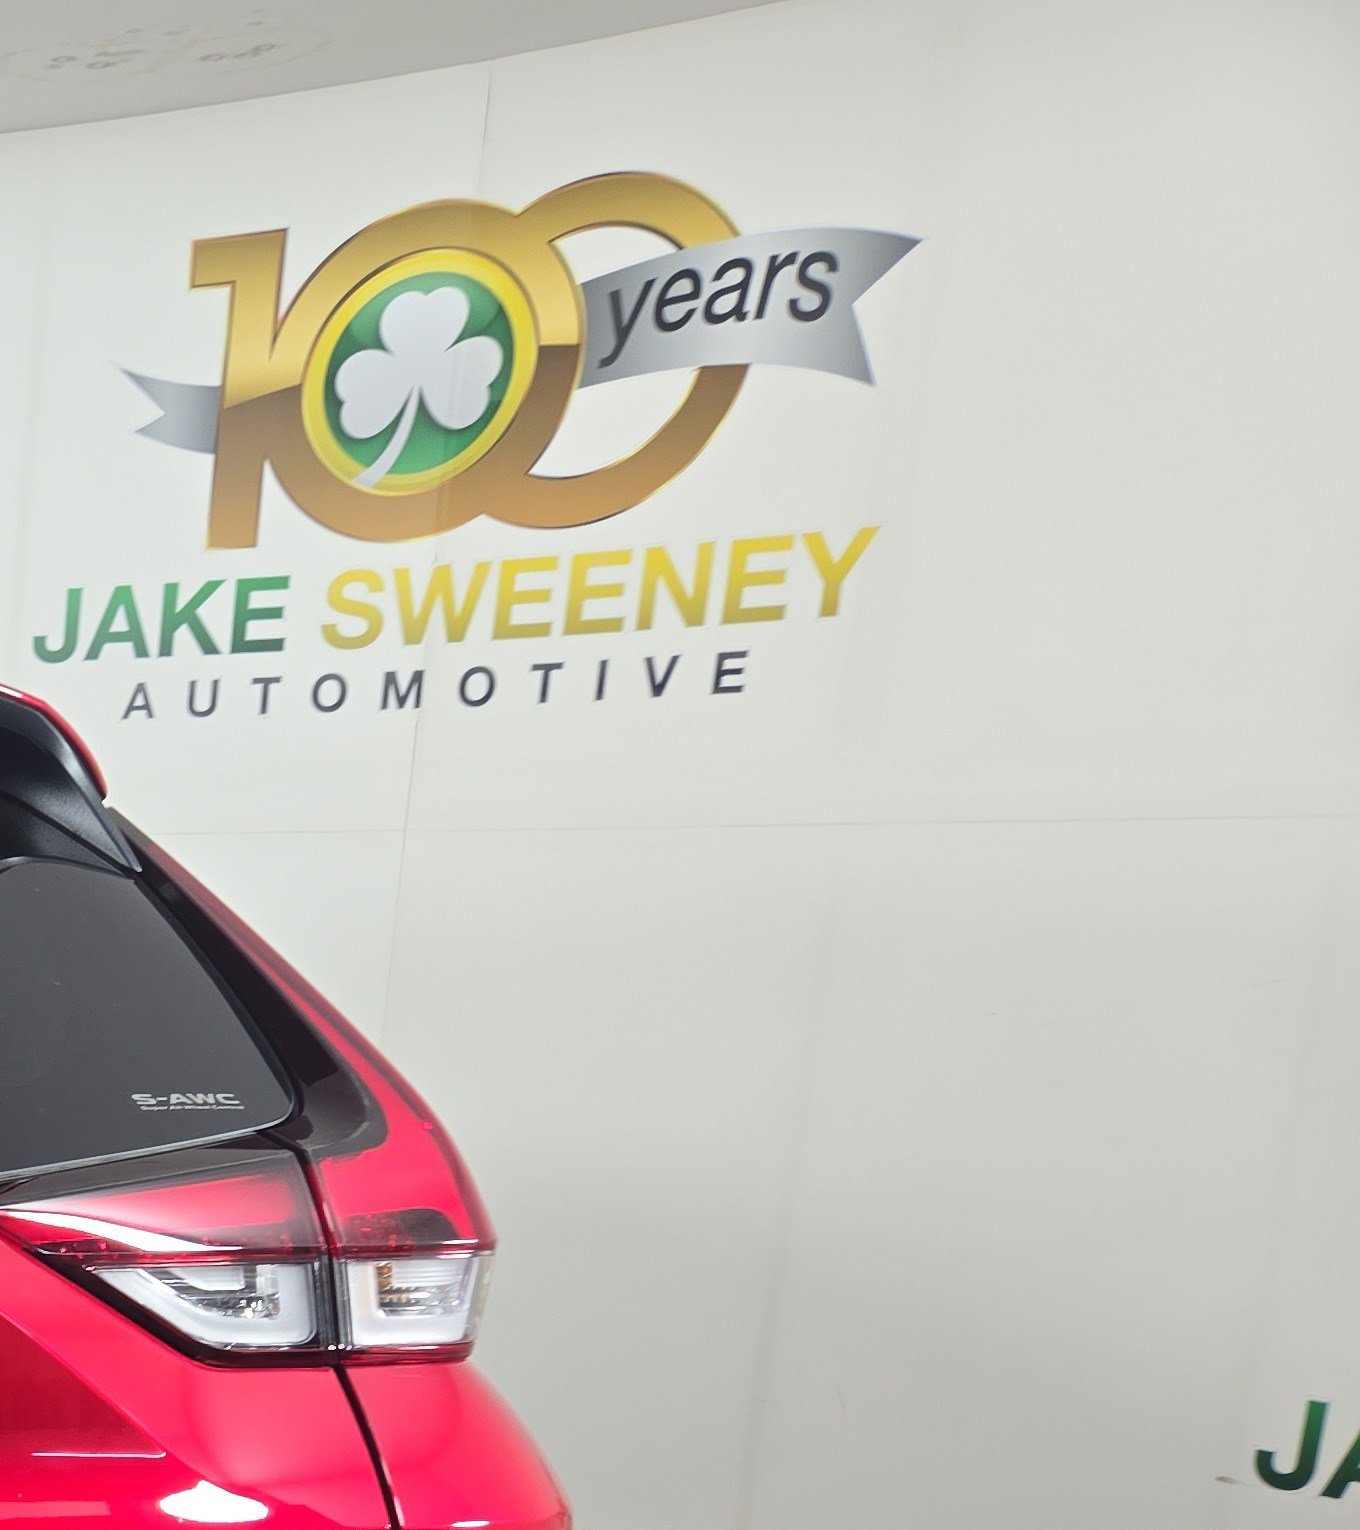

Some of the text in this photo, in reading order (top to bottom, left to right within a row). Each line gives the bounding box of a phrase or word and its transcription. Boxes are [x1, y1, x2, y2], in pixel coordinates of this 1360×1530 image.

[189, 171, 750, 550] 100
[597, 248, 839, 370] years
[32, 526, 881, 664] JAKE SWEENEY
[122, 649, 750, 722] AUTOMOTIVE
[131, 1093, 241, 1105] S-AWC
